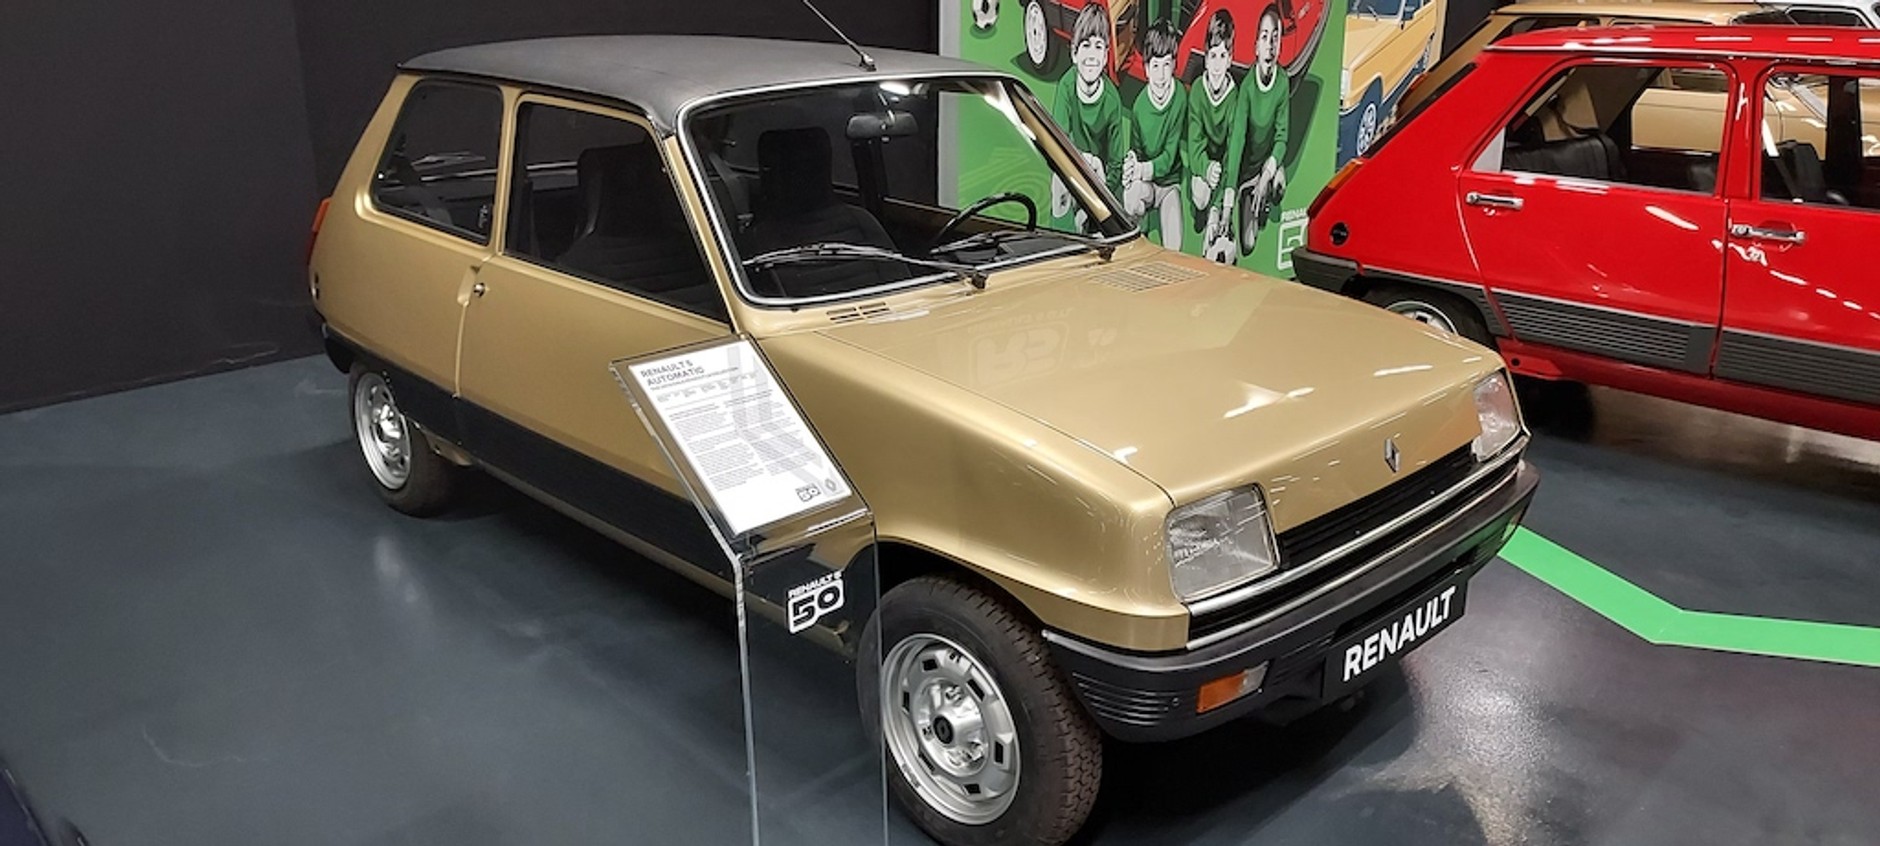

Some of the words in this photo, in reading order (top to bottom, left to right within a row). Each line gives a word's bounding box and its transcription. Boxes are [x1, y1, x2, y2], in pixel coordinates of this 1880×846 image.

[640, 361, 685, 377] RENAULT
[647, 366, 704, 386] AUTOMATIC
[788, 572, 833, 599] RENAULT
[790, 582, 843, 631] 50
[1343, 585, 1456, 682] RENAULT
